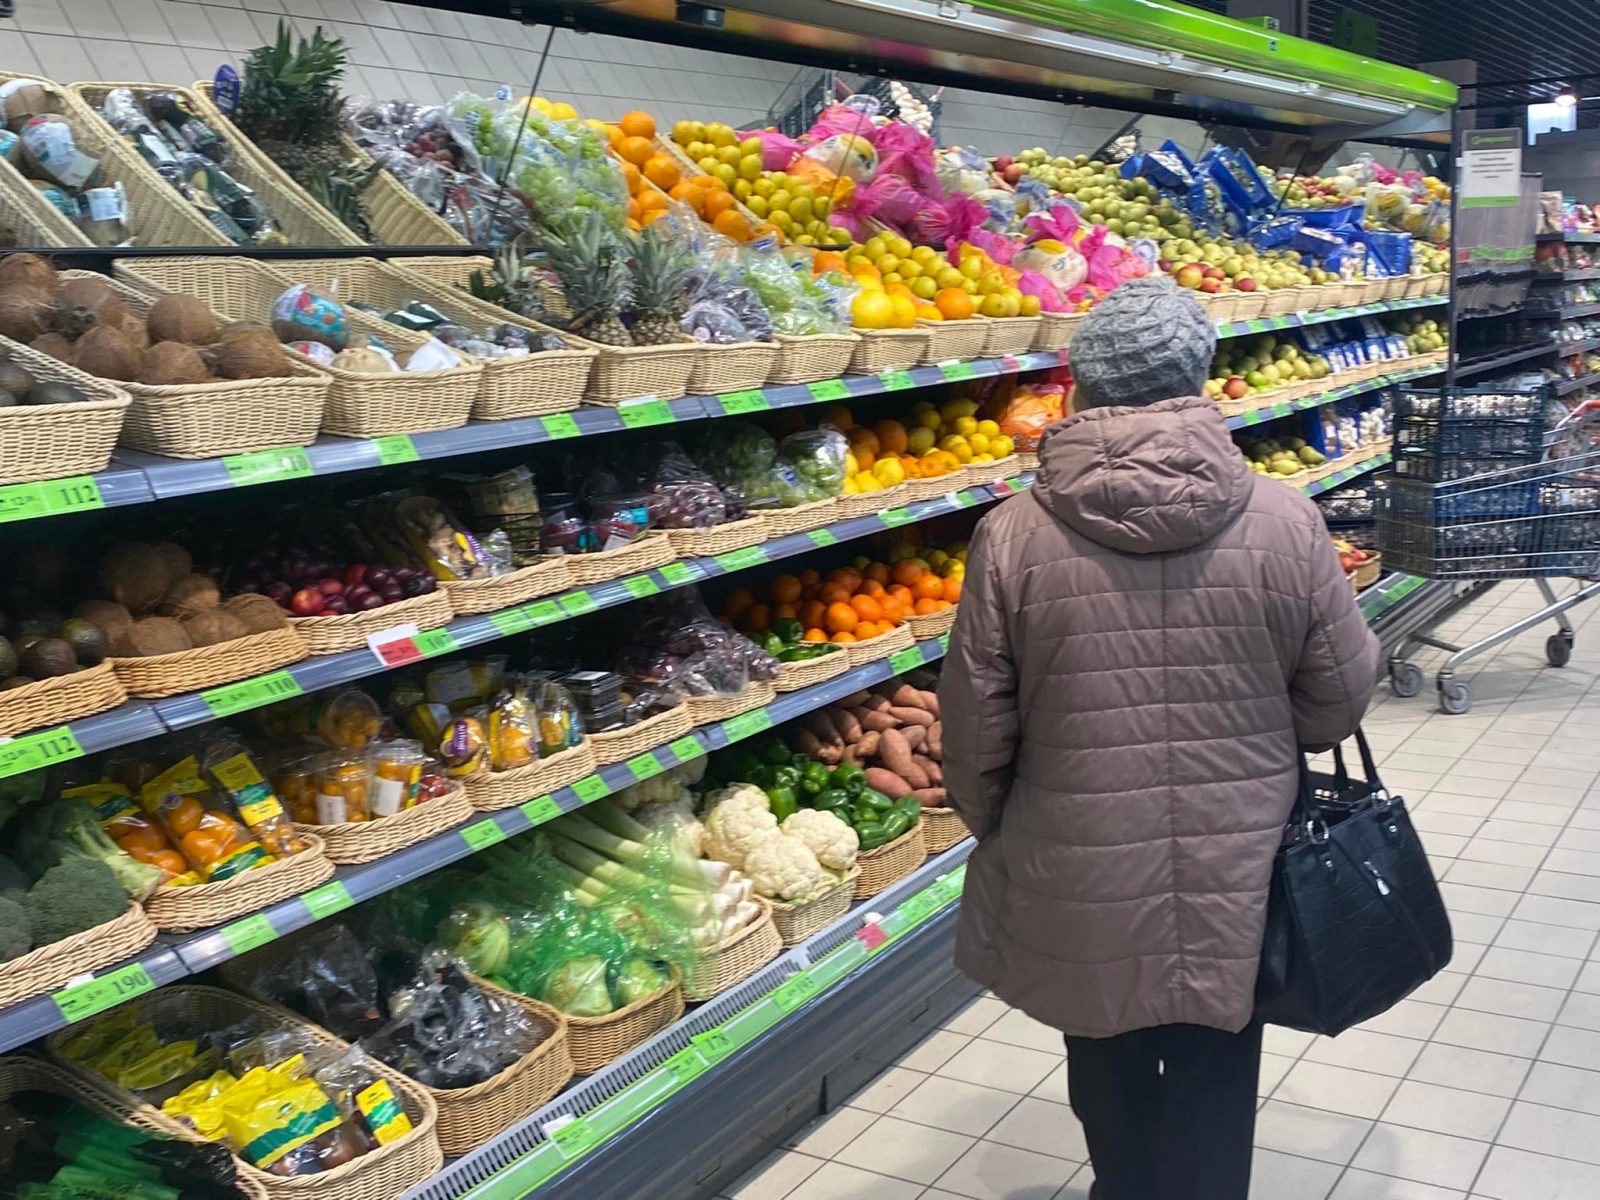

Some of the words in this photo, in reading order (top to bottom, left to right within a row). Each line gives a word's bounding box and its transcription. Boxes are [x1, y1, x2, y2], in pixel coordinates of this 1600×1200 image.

[59, 485, 97, 505] 112
[264, 678, 297, 695] 110
[38, 736, 76, 758] 112
[112, 971, 149, 995] 190
